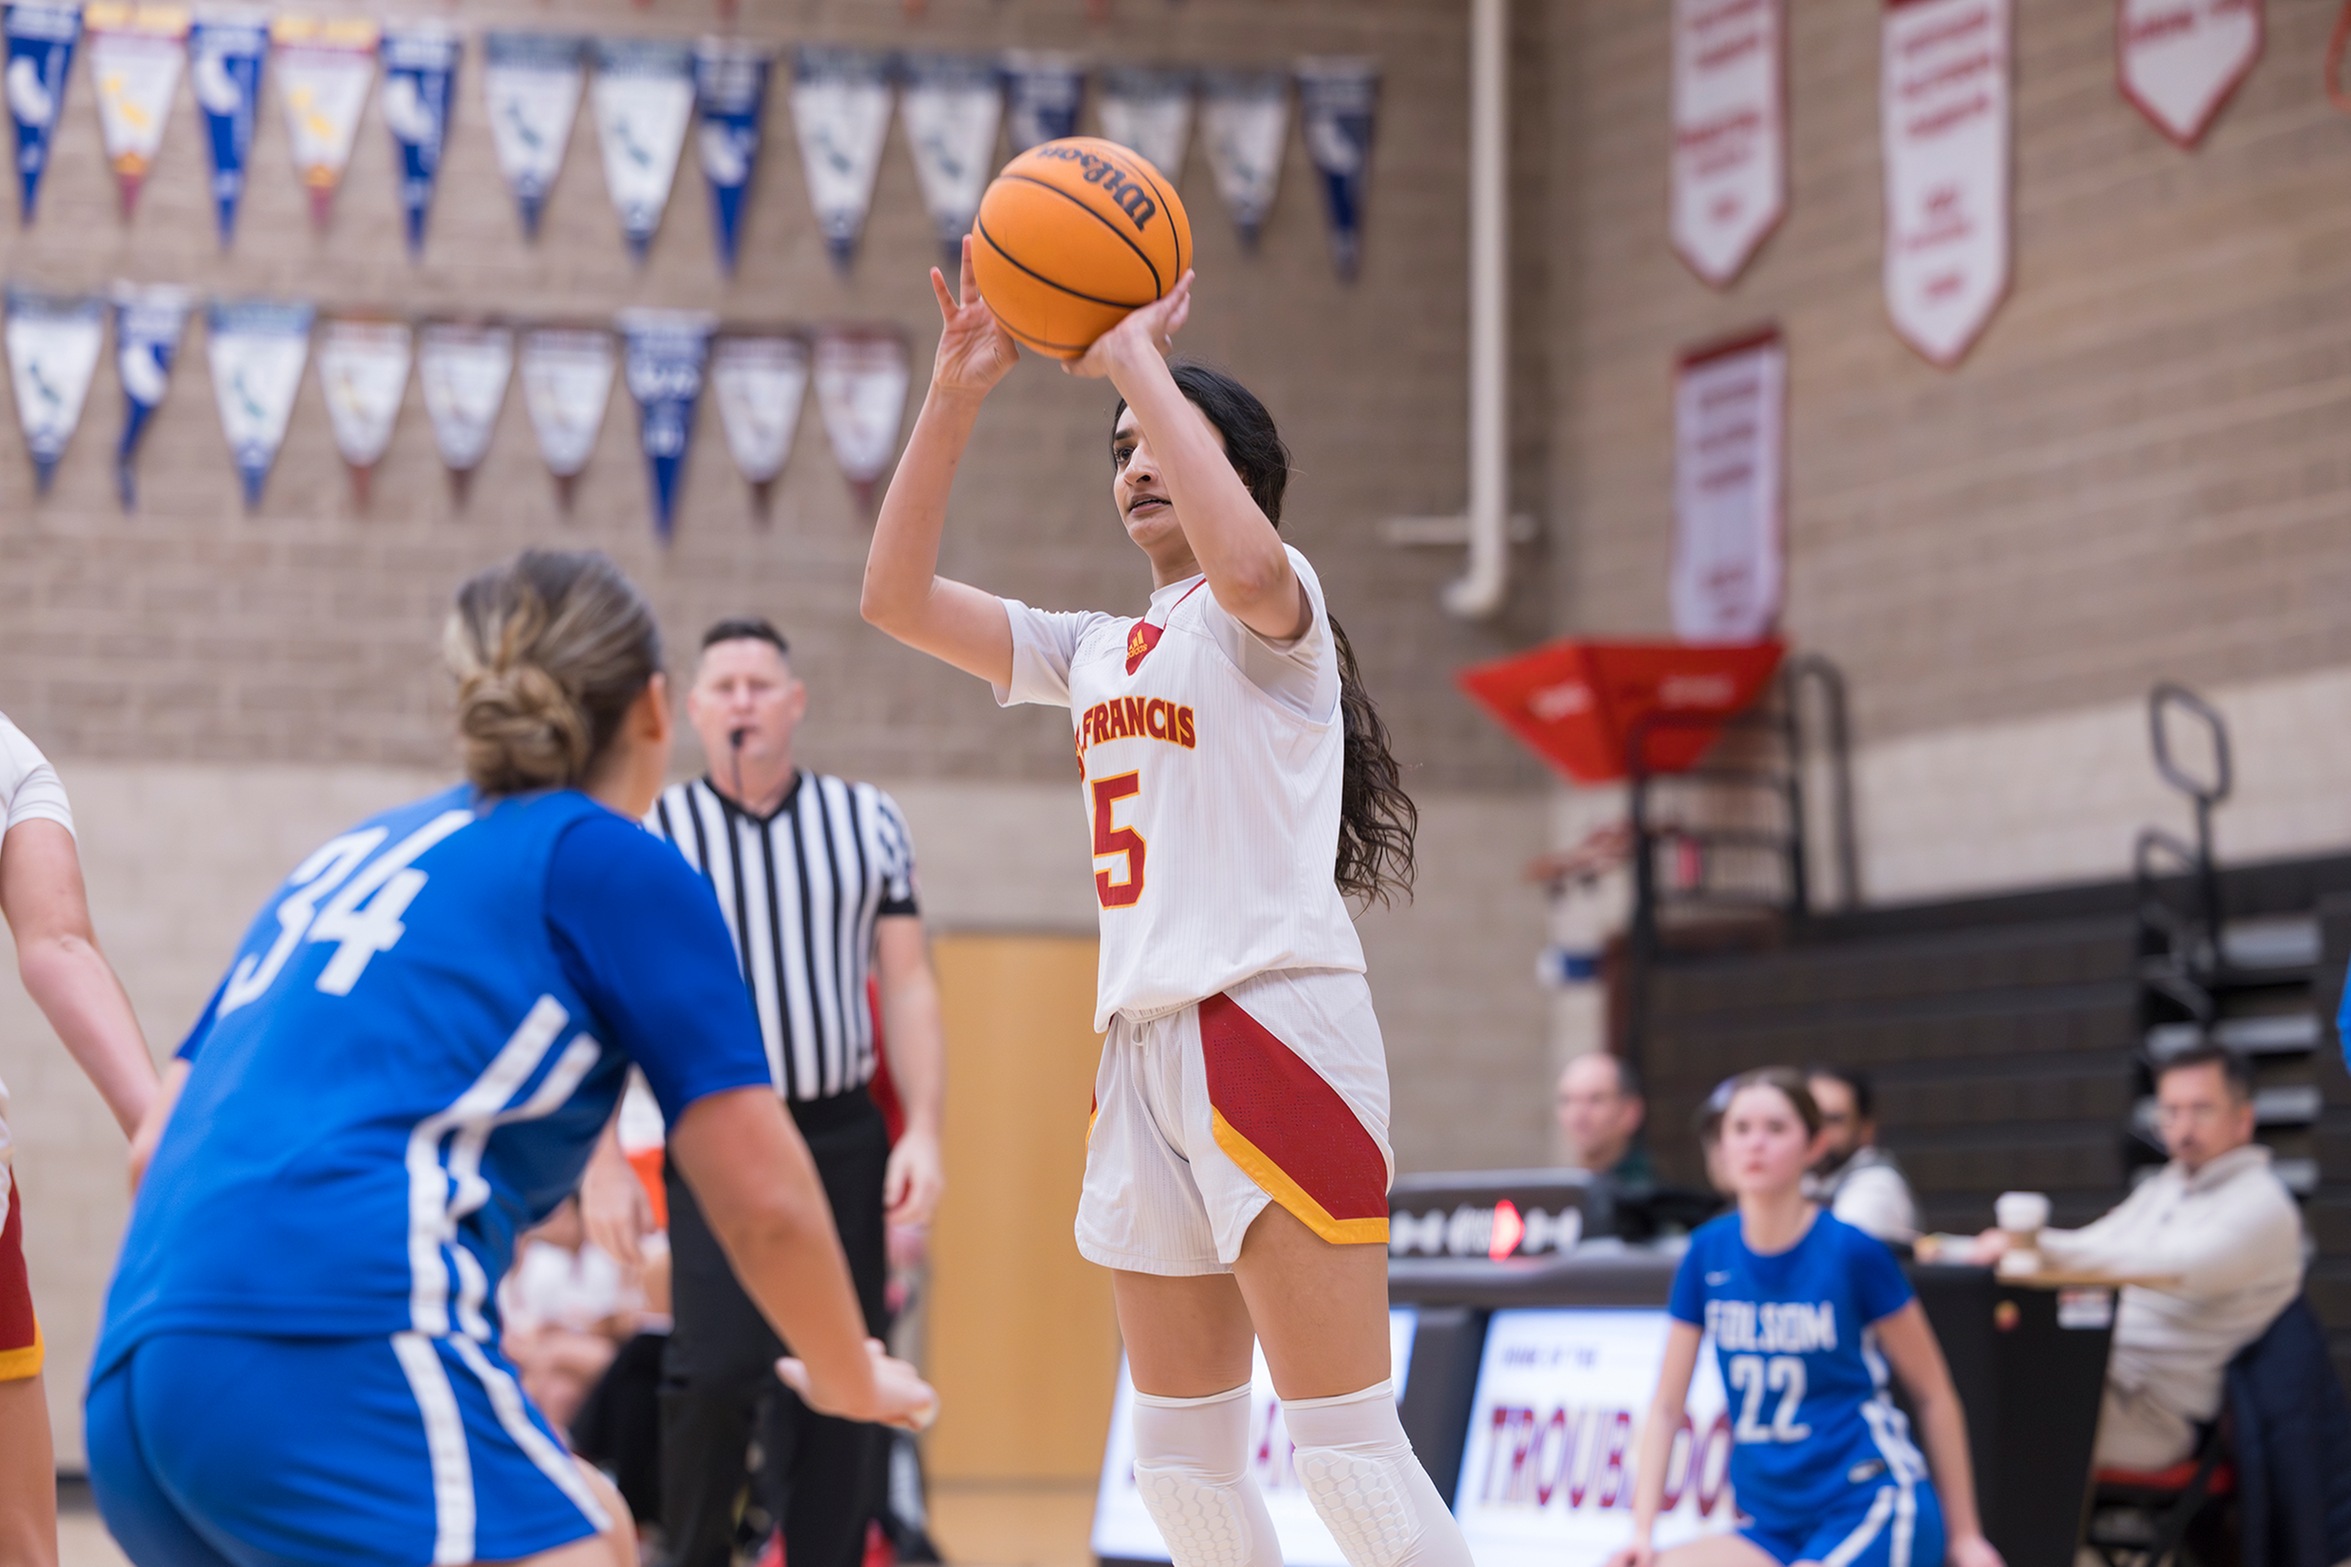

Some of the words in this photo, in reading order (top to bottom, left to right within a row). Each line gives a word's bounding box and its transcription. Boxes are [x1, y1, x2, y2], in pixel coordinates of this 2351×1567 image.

[1037, 148, 1156, 232] Wilson
[1082, 695, 1197, 751] FRANCIS
[1090, 769, 1147, 911] 5
[216, 809, 478, 1019] 34
[1704, 1299, 1837, 1352] FOLSOM
[1729, 1354, 1812, 1444] 22
